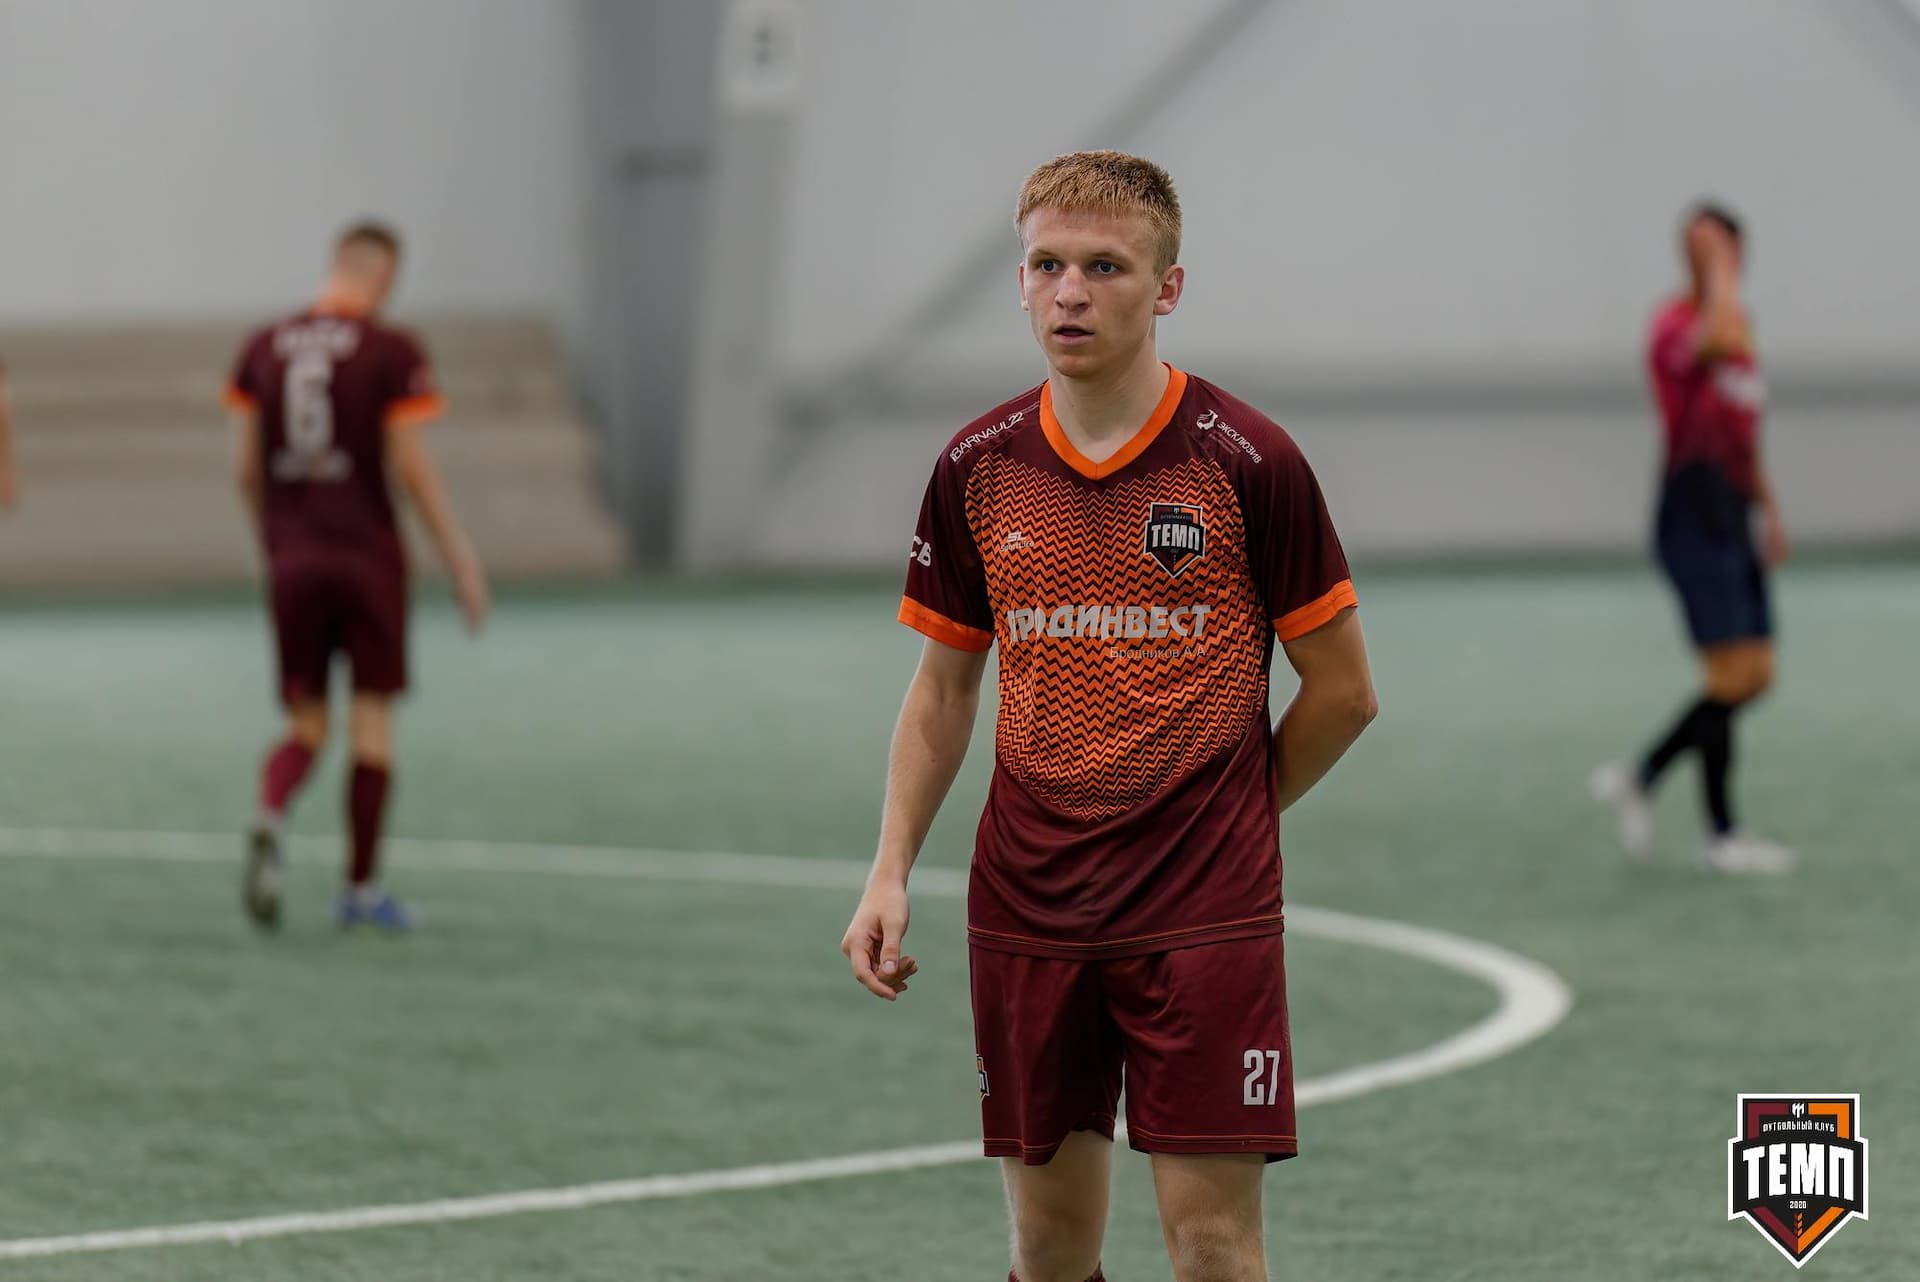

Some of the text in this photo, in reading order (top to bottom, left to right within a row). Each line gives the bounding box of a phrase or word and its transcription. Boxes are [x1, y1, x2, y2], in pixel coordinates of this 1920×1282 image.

[1216, 421, 1263, 464] ЭКСКЛЮЗИВ
[1151, 523, 1200, 551] ТЕМП
[1110, 646, 1180, 661] Бродников
[1242, 1049, 1281, 1106] 27
